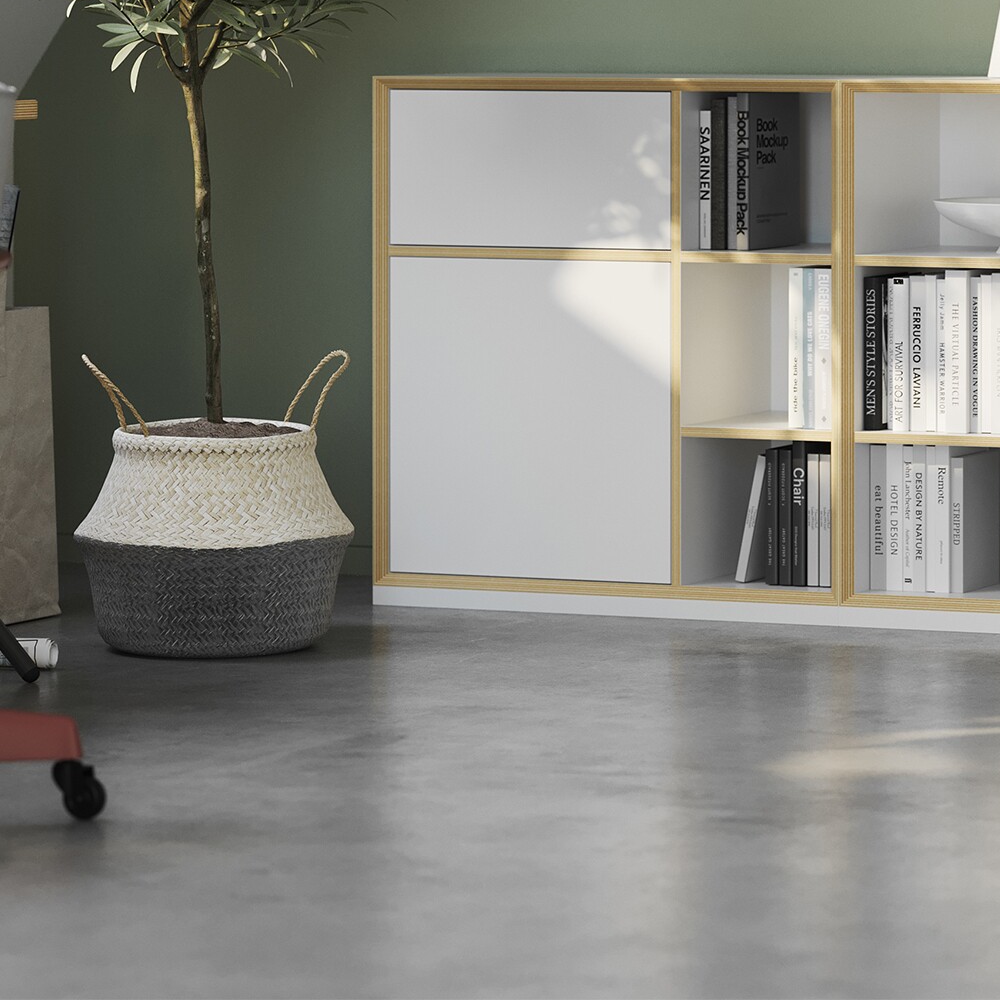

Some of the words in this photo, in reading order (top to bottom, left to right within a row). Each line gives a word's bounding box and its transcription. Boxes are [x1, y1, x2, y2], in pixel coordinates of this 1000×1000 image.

[737, 111, 749, 145] Book
[756, 118, 778, 132] Book
[756, 134, 788, 150] Mockup
[700, 127, 710, 200] SAARINEN
[737, 147, 749, 201] Mockup
[756, 151, 776, 165] Pack
[737, 203, 748, 235] Pack
[866, 289, 876, 338] STORIES
[912, 306, 921, 364] FERRUCCIO
[866, 339, 876, 379] STYLE
[895, 341, 904, 382] SURVIVAL
[866, 380, 876, 416] MEN'S
[895, 384, 904, 402] FOR
[912, 368, 921, 409] LAVIANI
[972, 377, 978, 386] IN
[895, 406, 904, 423] ART
[793, 467, 805, 506] Chair
[904, 461, 912, 478] John
[938, 467, 946, 505] Remote
[890, 485, 898, 516] HOTEL
[904, 480, 912, 520] Lanchester
[915, 510, 922, 521] BY
[875, 506, 883, 555] beautiful
[890, 520, 898, 556] DESIGN
